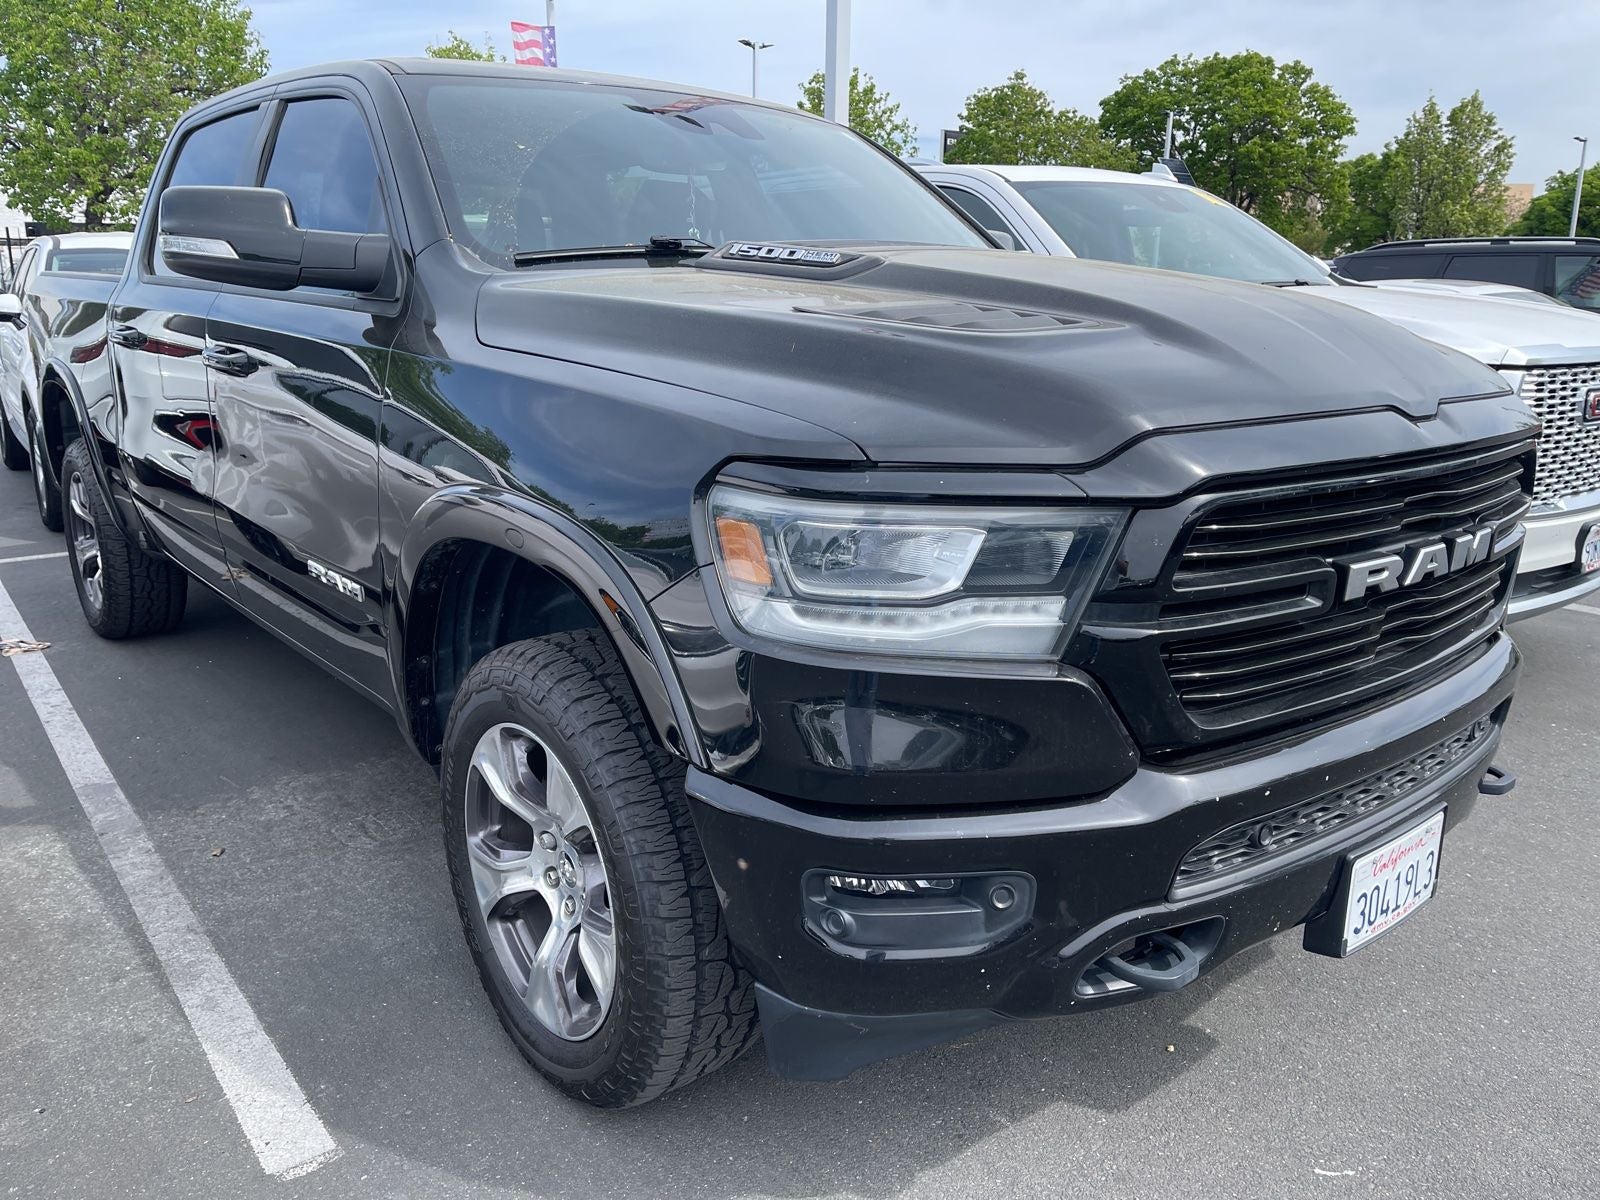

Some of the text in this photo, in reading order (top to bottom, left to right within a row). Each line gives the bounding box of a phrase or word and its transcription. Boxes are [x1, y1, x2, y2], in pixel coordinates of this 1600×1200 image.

[728, 243, 806, 260] 1500
[1344, 526, 1492, 601] RAM
[1371, 837, 1427, 878] California
[1353, 850, 1435, 935] 30419L3
